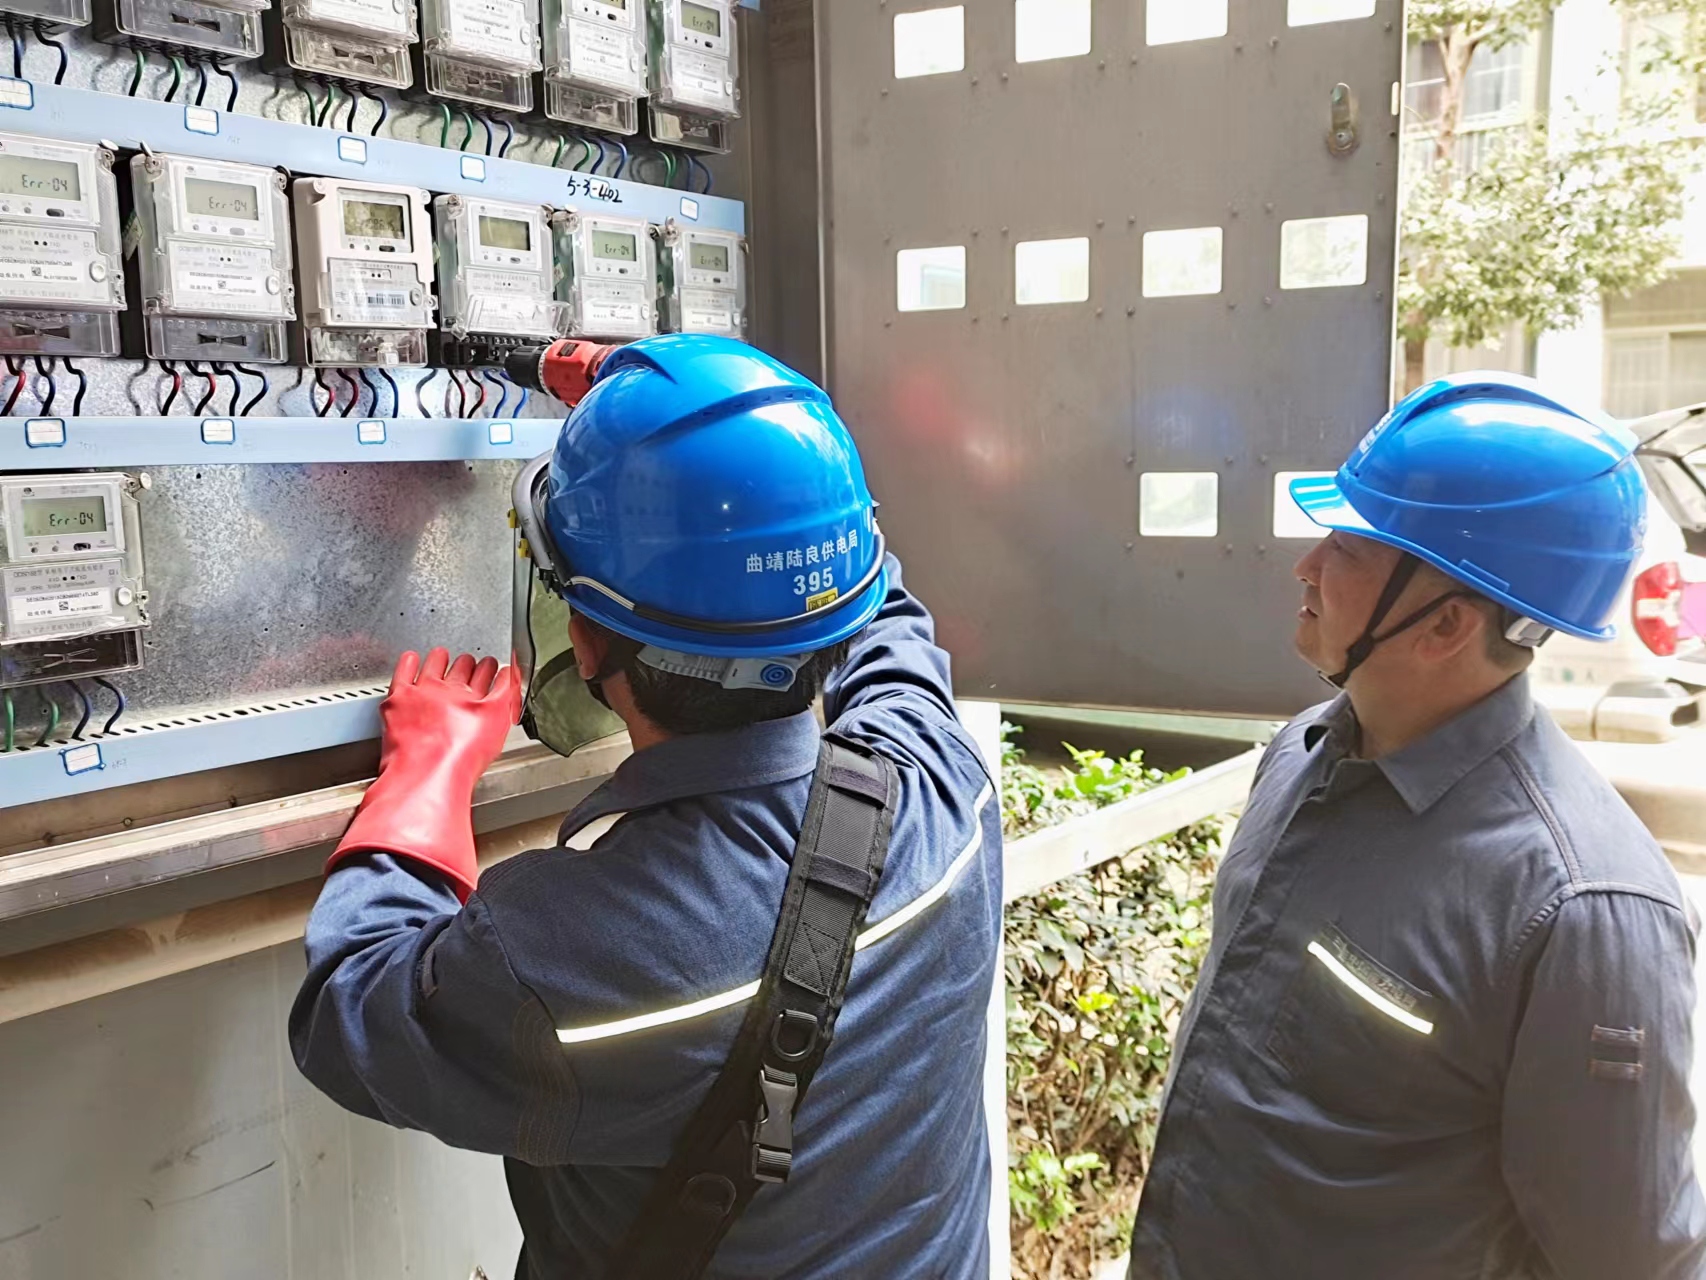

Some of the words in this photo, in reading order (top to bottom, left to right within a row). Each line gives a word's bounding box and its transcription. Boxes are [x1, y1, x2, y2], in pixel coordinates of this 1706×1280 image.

[21, 173, 69, 192] Err-04
[567, 174, 623, 203] 5-3-402
[208, 196, 248, 212] Err-04
[49, 512, 94, 527] Err-04
[746, 529, 858, 573] 曲靖陆良供电局
[793, 566, 834, 596] 395
